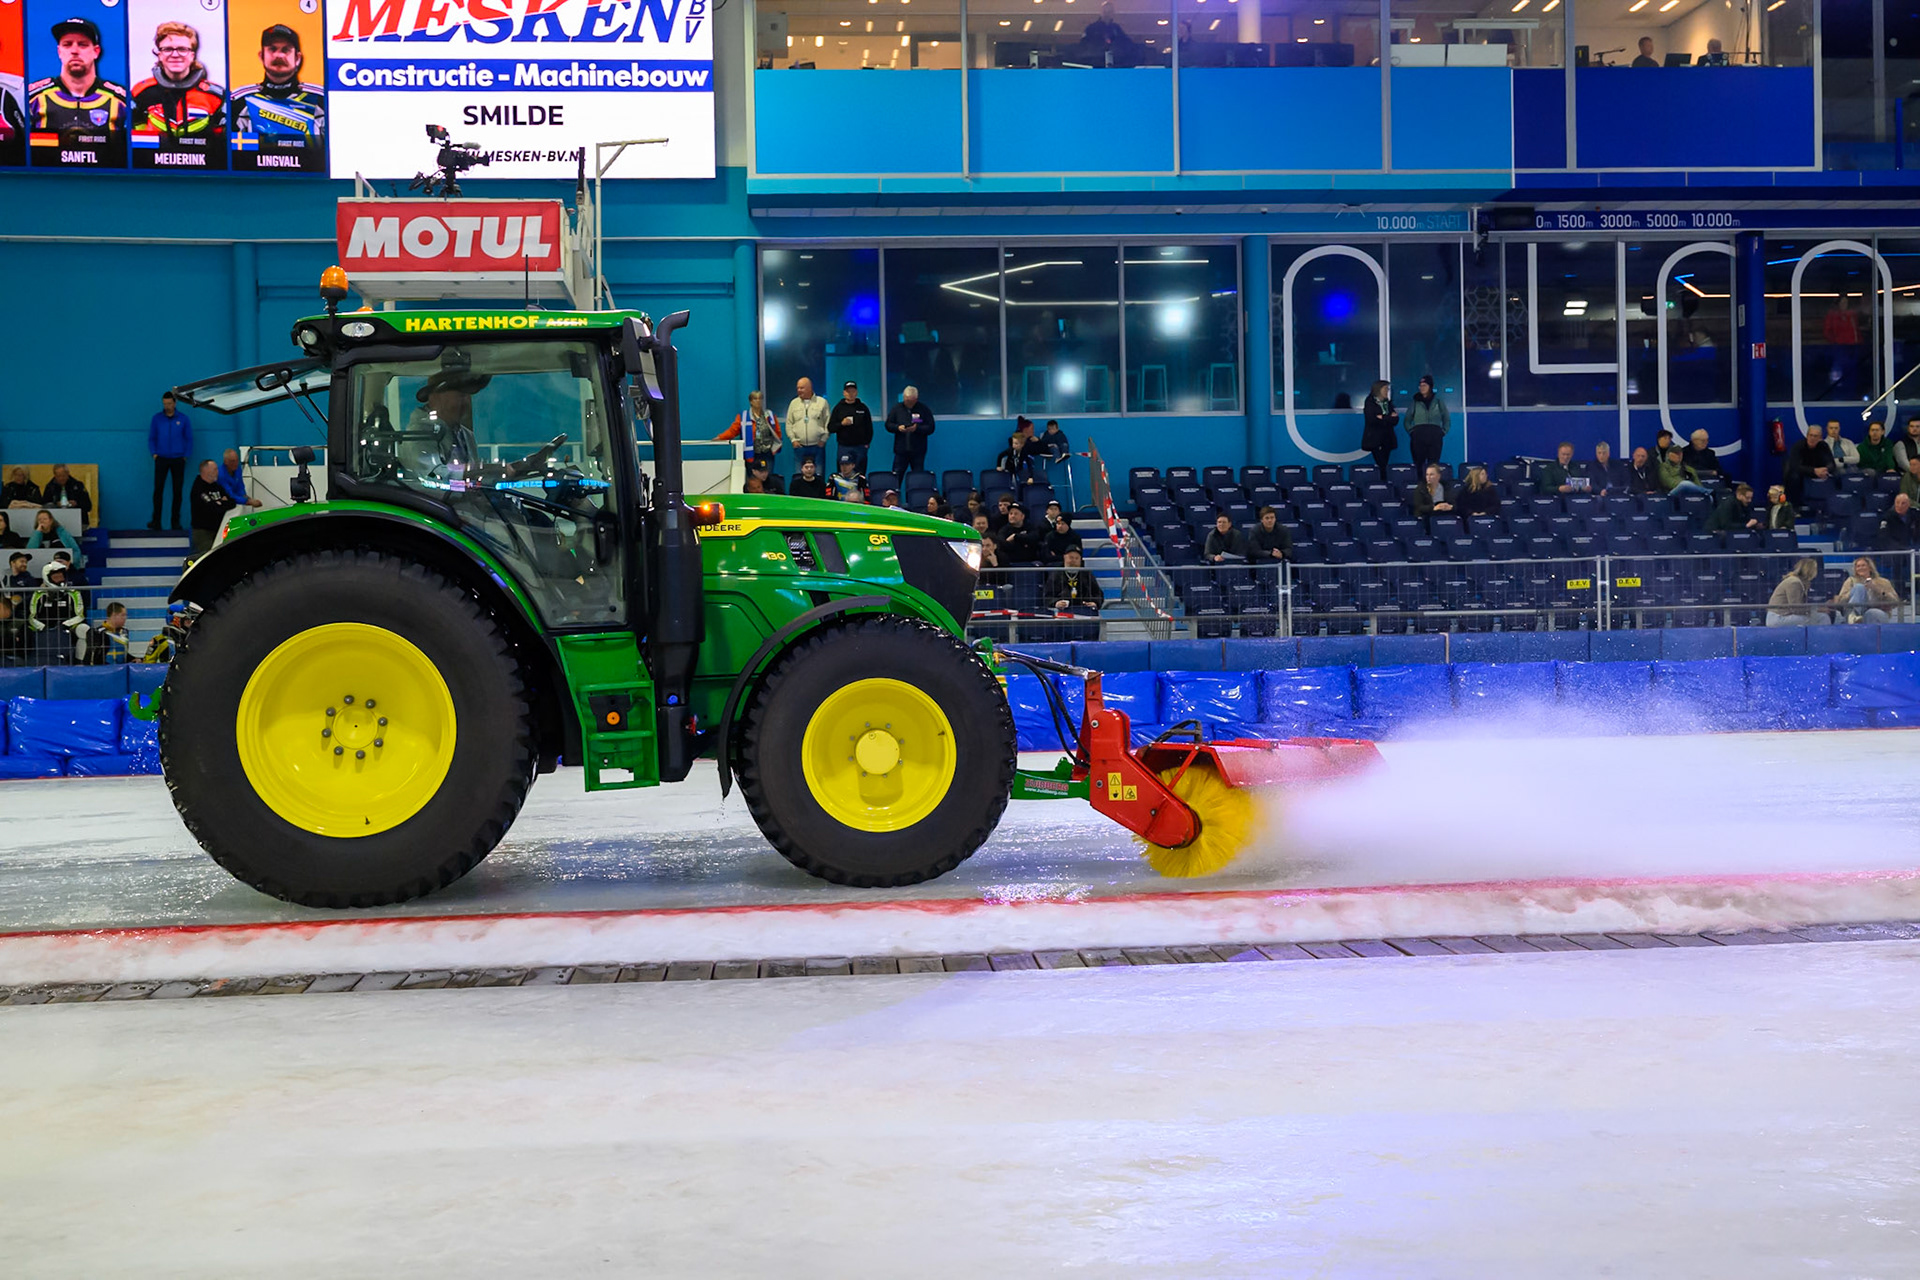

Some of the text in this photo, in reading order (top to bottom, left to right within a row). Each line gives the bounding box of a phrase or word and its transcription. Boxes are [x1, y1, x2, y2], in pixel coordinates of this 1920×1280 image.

[332, 0, 681, 44] MESKEN
[338, 63, 494, 87] Constructie
[513, 63, 709, 87] Machinebouw
[258, 108, 308, 133] SWEDEN
[463, 105, 564, 126] SMILDE
[61, 150, 98, 164] SANFTL
[154, 152, 206, 166] MEIJERINK
[256, 154, 301, 168] LINGVALL
[1426, 214, 1462, 230] START
[345, 216, 552, 259] MOTUL
[405, 315, 588, 332] HARTENHOF ASSEN
[705, 524, 742, 532] DEERE
[868, 534, 889, 546] 6R
